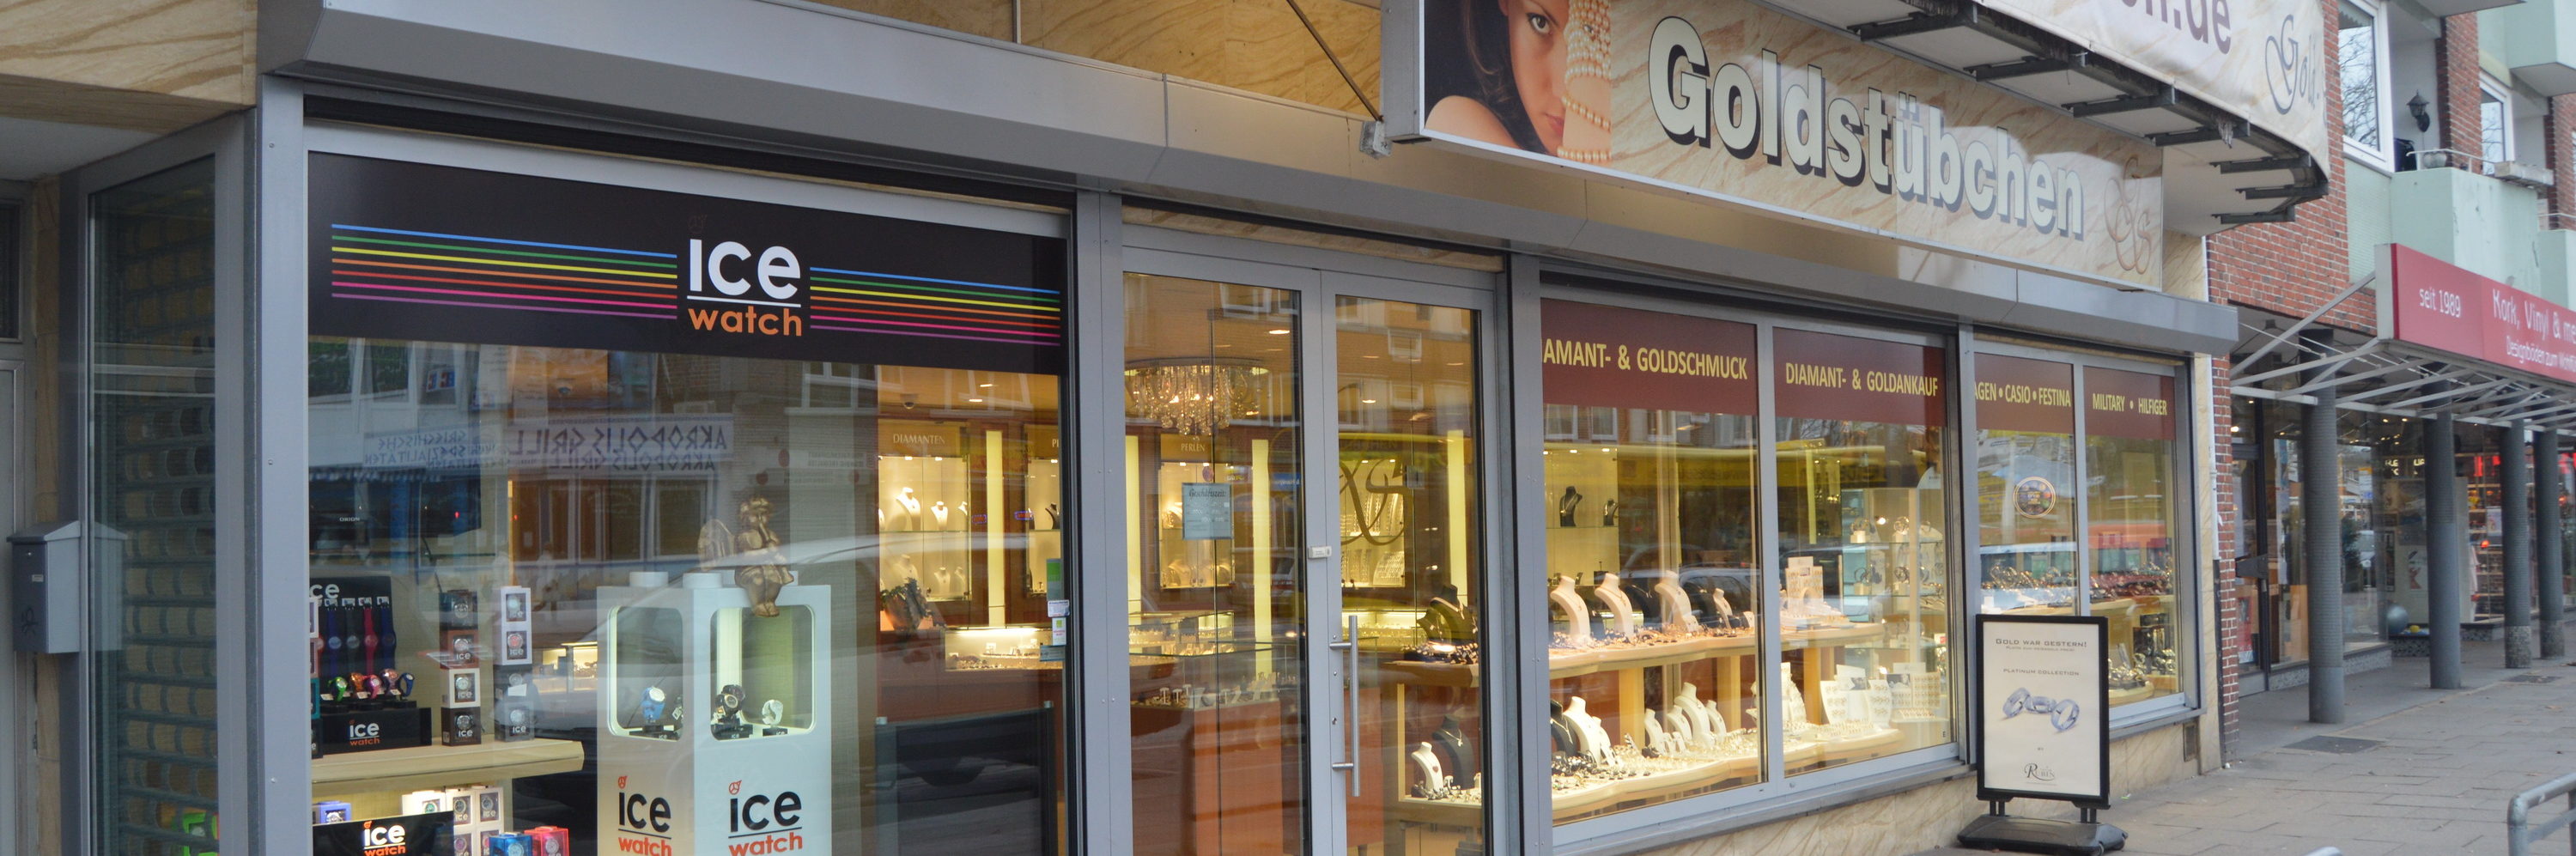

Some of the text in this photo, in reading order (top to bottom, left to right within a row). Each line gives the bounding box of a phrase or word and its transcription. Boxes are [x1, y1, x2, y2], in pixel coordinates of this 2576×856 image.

[1649, 16, 2084, 240] Goldstübchen
[2419, 287, 2461, 318] seit 1989
[2493, 288, 2520, 330] Kork,
[688, 306, 802, 336] watch
[1543, 338, 1747, 379] AMANT- & GOLDSCHMUCK
[1786, 362, 1938, 397] DIAMANT- & GOLDANKAUF
[2005, 385, 2030, 404] CASIO
[2038, 387, 2071, 407] FESTINA
[2093, 393, 2167, 416] MILITARY HILFIGER
[893, 434, 945, 445] DIAMANTEN
[1182, 443, 1206, 452] PERLEN
[309, 584, 340, 599] ce
[350, 738, 380, 746] watch
[364, 845, 406, 856] watch
[618, 837, 671, 856] watch
[729, 832, 803, 856] watch
